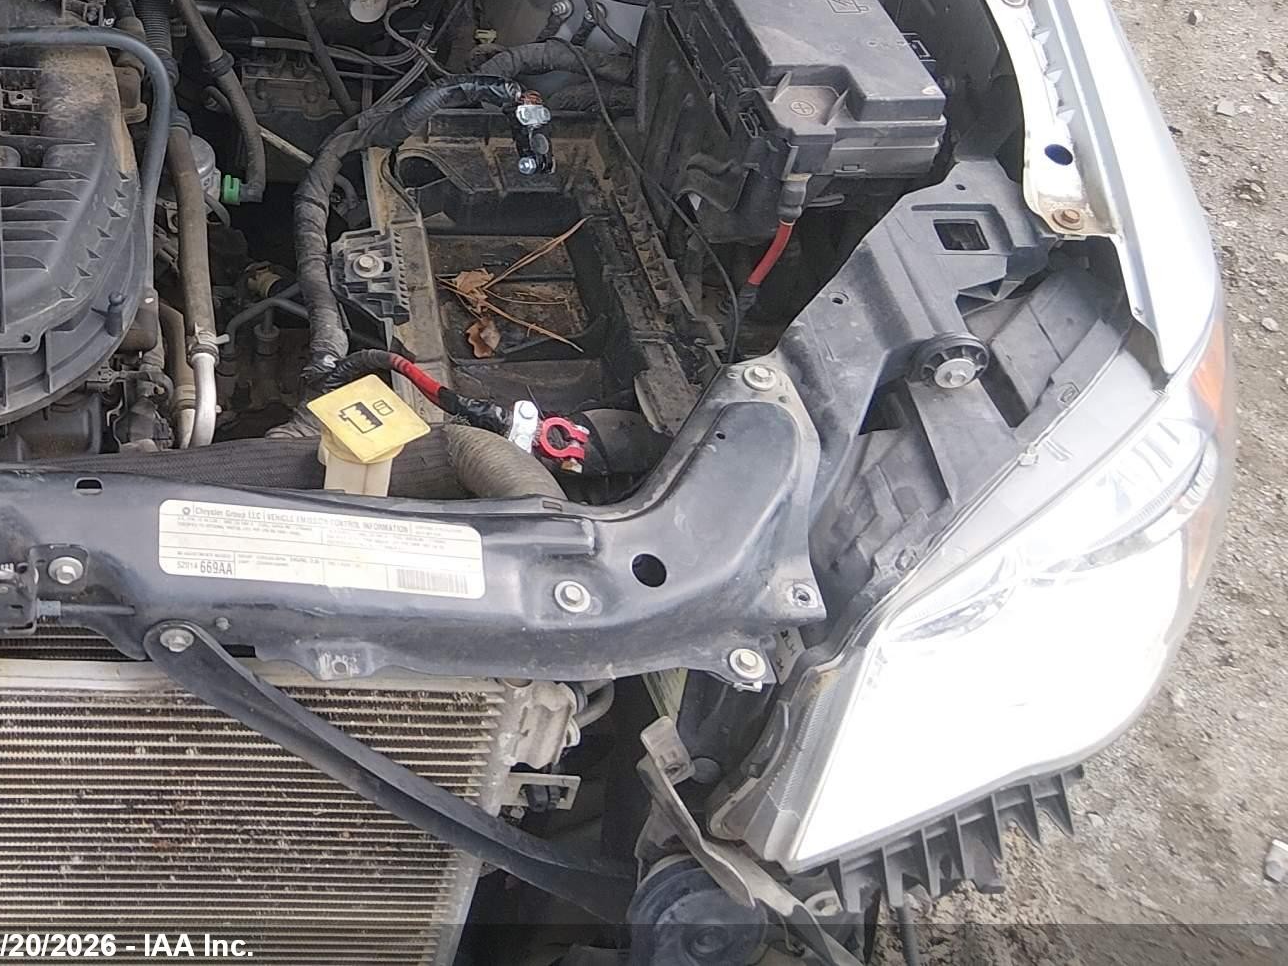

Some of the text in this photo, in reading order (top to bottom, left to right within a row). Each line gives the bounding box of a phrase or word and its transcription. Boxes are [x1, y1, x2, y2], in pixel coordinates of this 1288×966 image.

[195, 506, 223, 517] Chrysler
[225, 509, 246, 519] Group
[248, 510, 261, 520] LLC
[267, 512, 294, 523] VEHICLE
[330, 519, 360, 529] CONTROL
[363, 521, 409, 534] INFORMATION
[200, 560, 233, 575] 669AA
